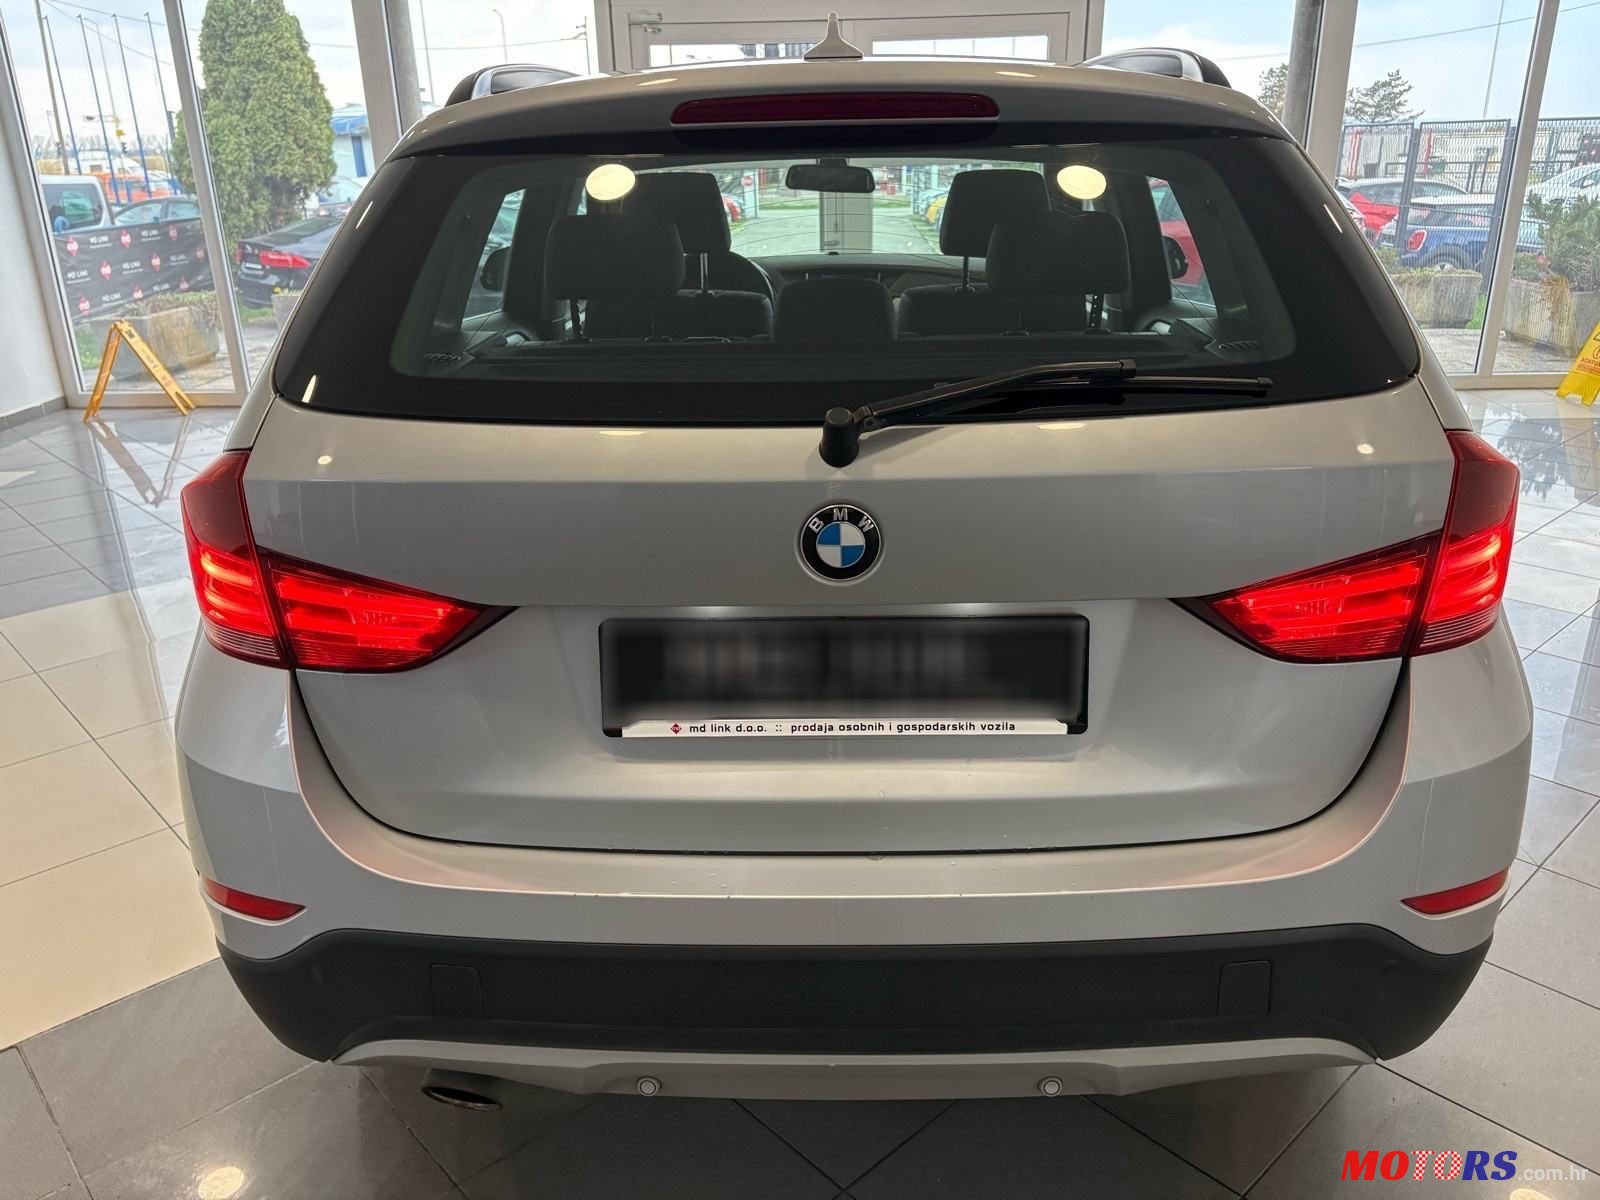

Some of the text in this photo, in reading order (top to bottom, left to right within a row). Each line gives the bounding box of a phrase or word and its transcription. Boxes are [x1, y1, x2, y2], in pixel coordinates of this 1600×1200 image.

[808, 507, 874, 534] BMW
[689, 723, 706, 733] md
[711, 723, 731, 733] link
[735, 723, 767, 733] d.o.o.
[791, 723, 834, 734] prodaja
[838, 722, 885, 732] osobnih
[896, 722, 975, 733] gospodarskih
[980, 722, 1016, 731] vozila
